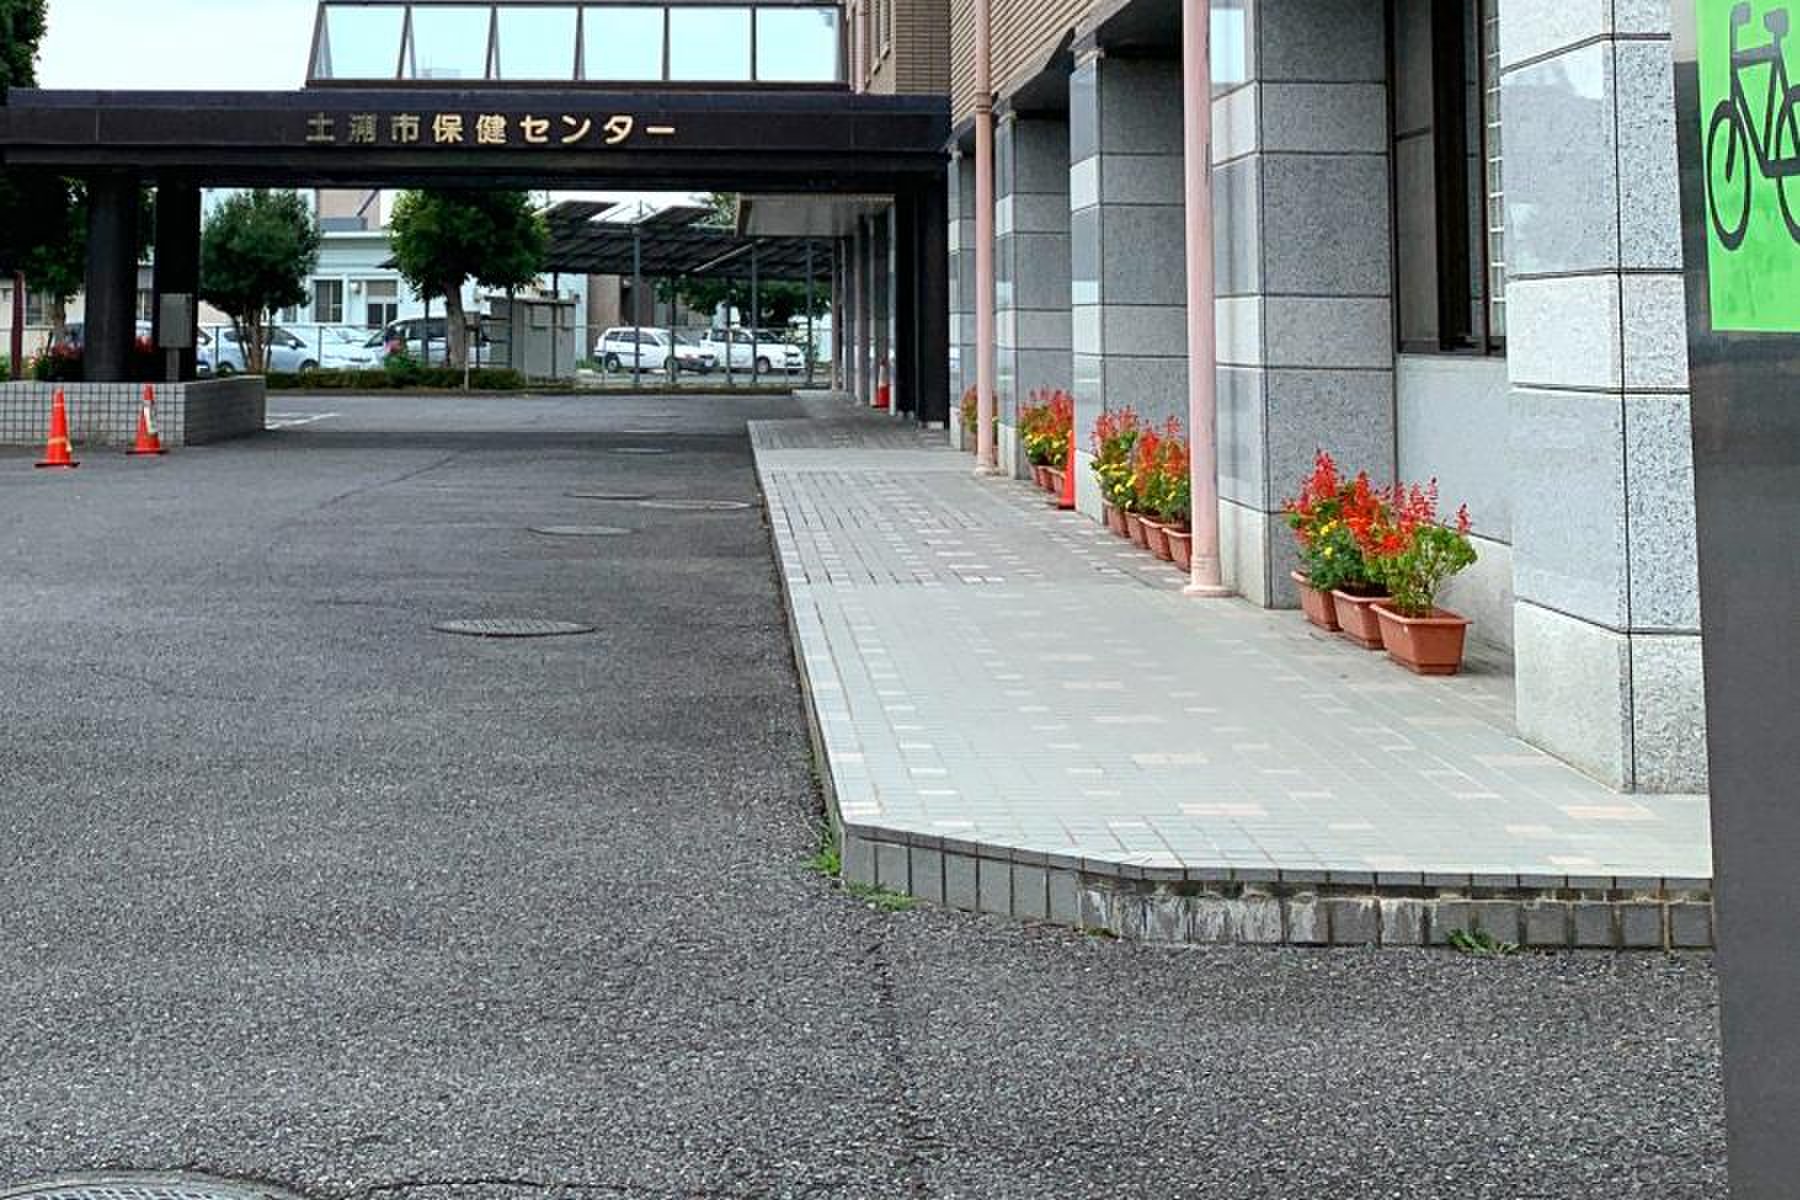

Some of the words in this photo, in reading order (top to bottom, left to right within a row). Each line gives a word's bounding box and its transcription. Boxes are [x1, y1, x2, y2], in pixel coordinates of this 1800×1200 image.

[305, 112, 676, 144] 土浦市保健センター
